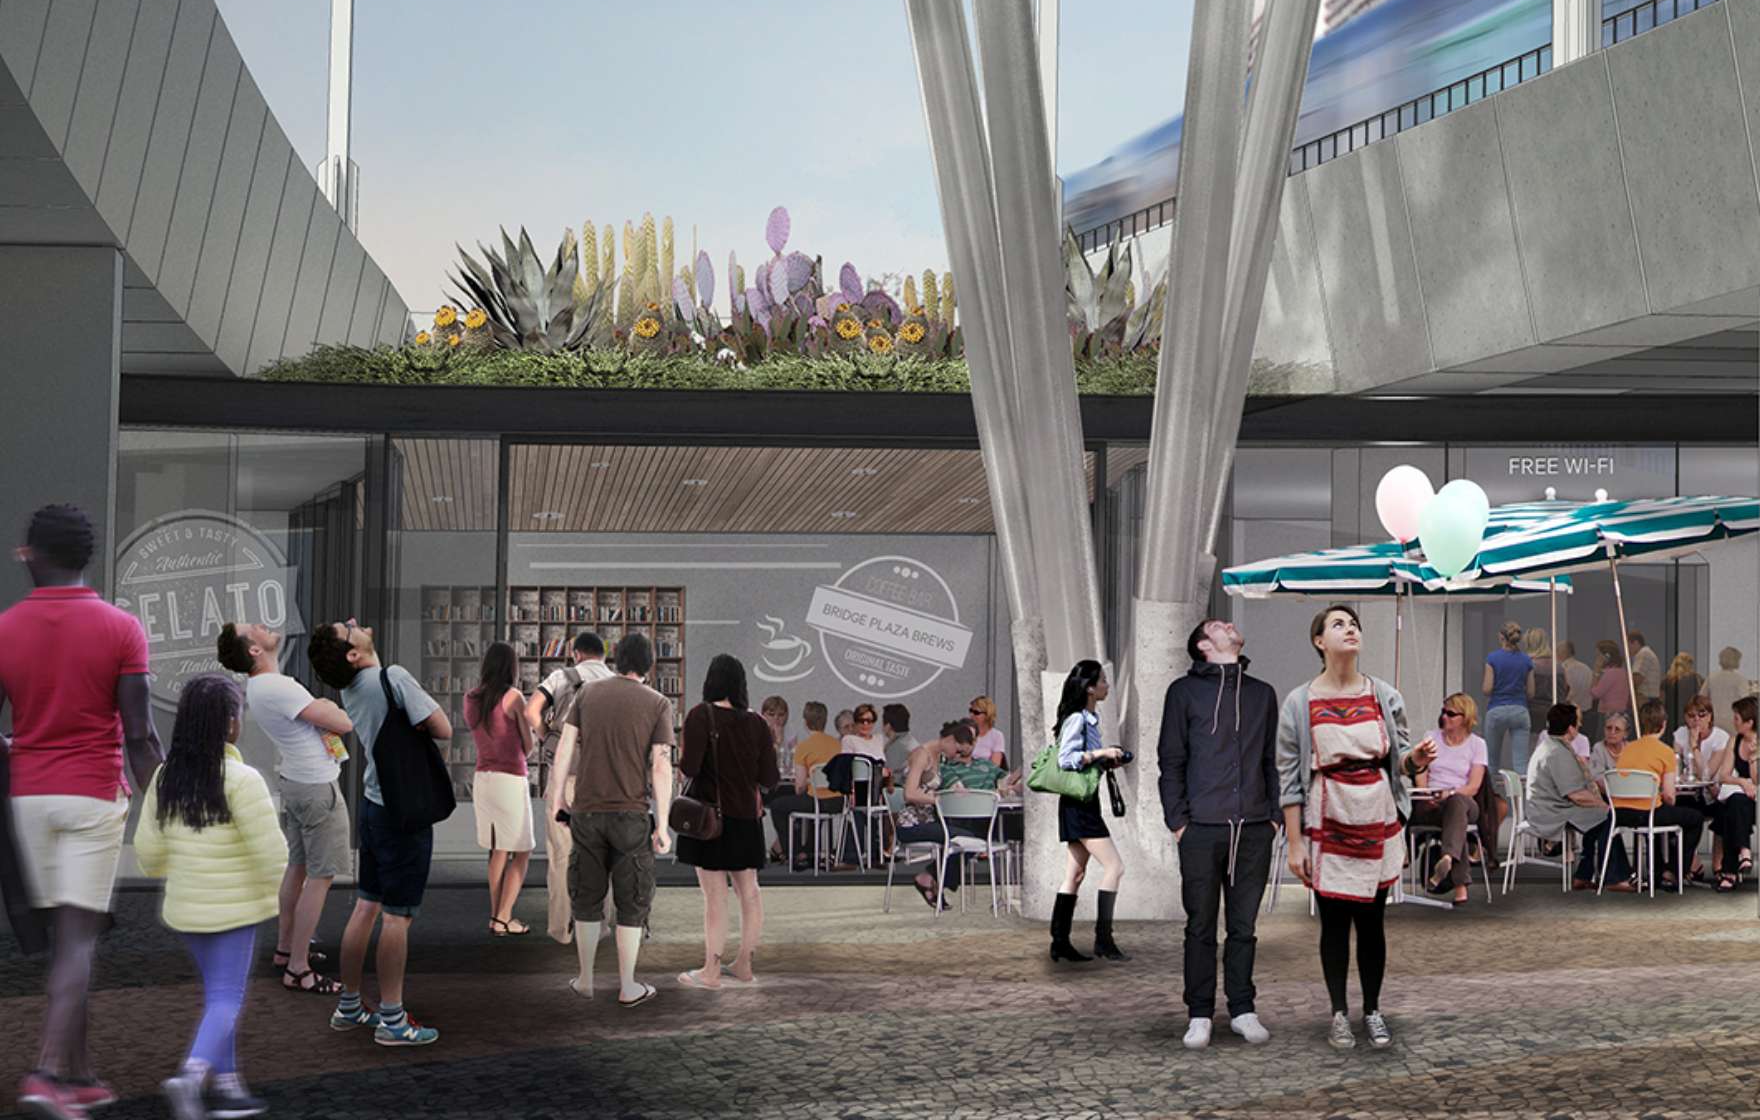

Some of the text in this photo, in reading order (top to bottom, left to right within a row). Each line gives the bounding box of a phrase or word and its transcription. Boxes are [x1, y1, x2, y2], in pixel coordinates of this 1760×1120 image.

[1509, 457, 1615, 475] FREE WI-FI
[139, 529, 180, 559] SWEET
[200, 527, 239, 548] TASTY
[156, 551, 223, 571] Authentic
[115, 579, 286, 643] ELATO
[822, 603, 956, 652] BRIDGE PLAZA BREWS
[844, 648, 912, 678] ORIGINAL TASTE
